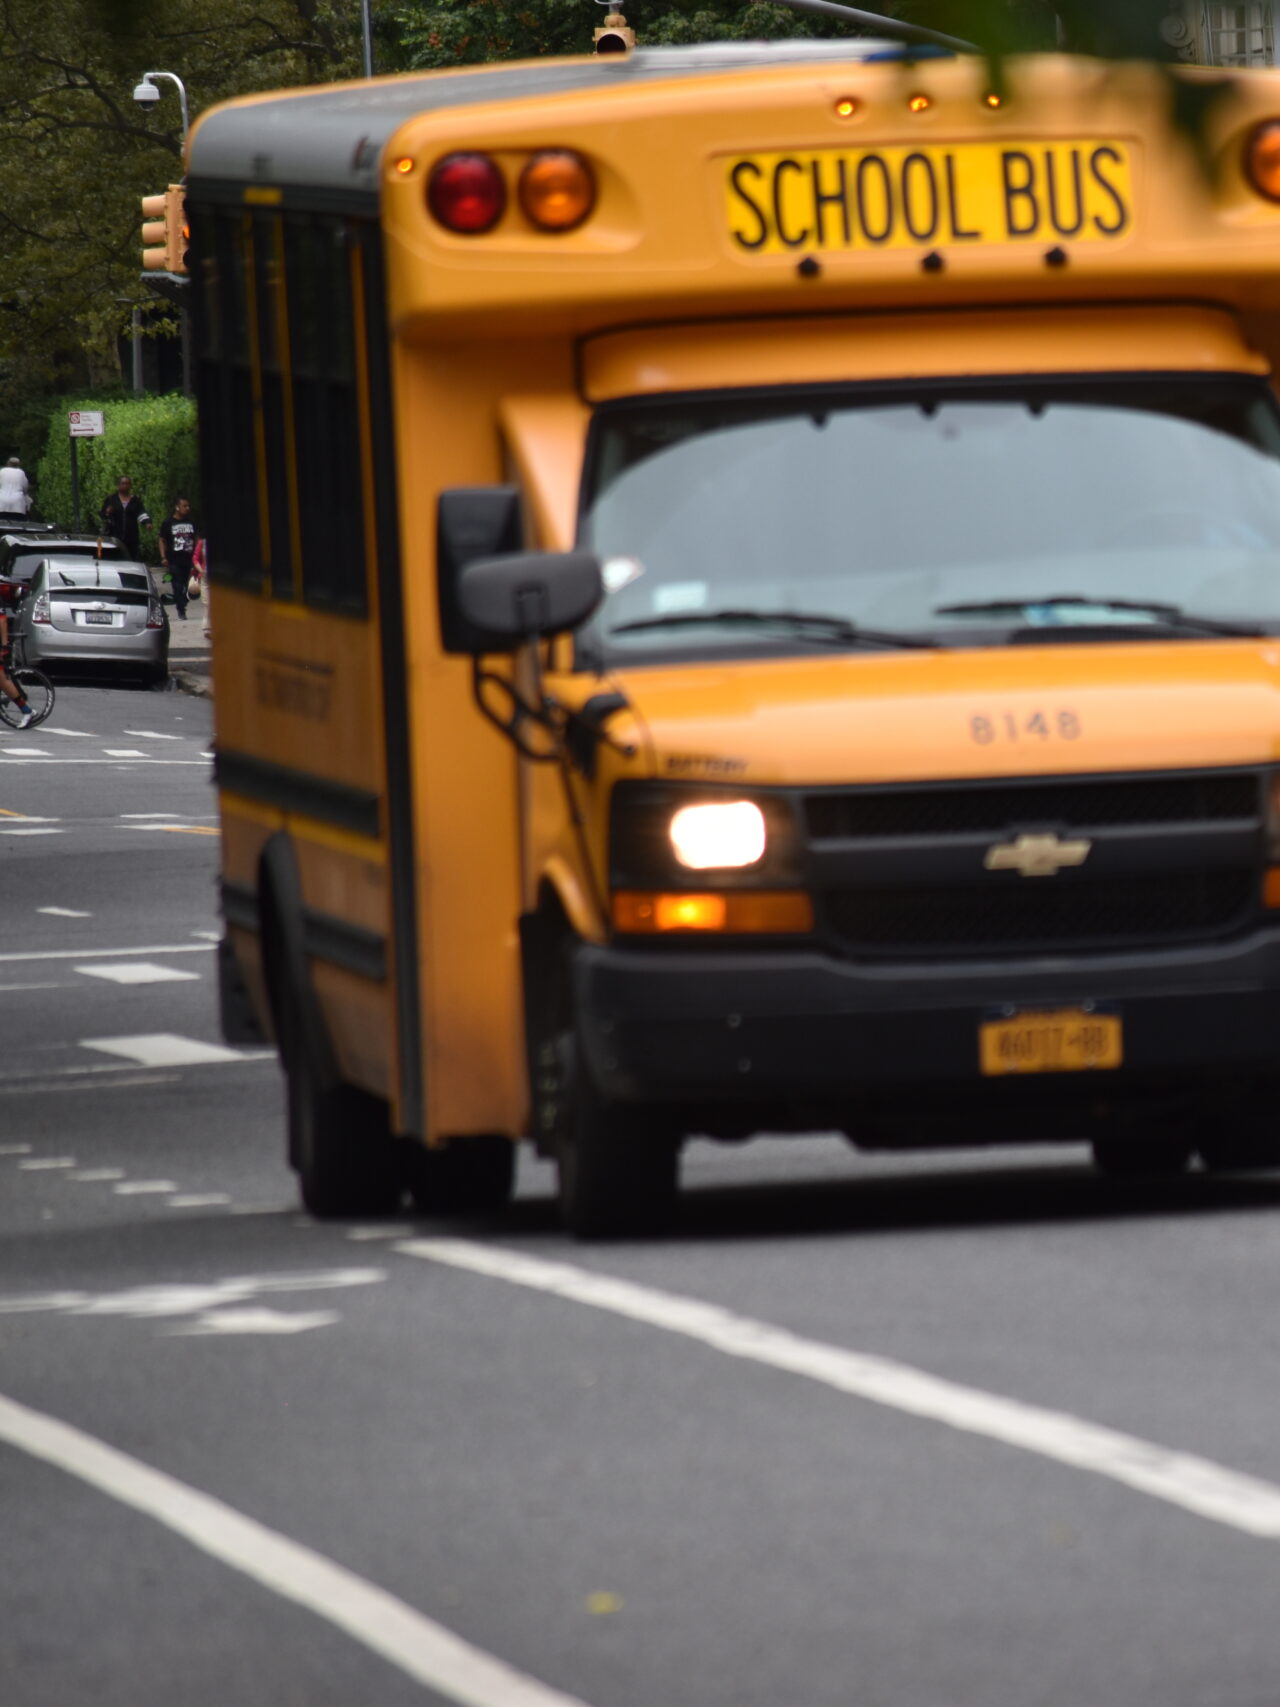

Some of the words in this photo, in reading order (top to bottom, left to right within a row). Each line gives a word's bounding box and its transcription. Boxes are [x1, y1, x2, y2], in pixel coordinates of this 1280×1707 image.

[730, 151, 981, 249] SCHOOL
[1001, 146, 1127, 238] BUS
[970, 710, 1082, 746] 8148
